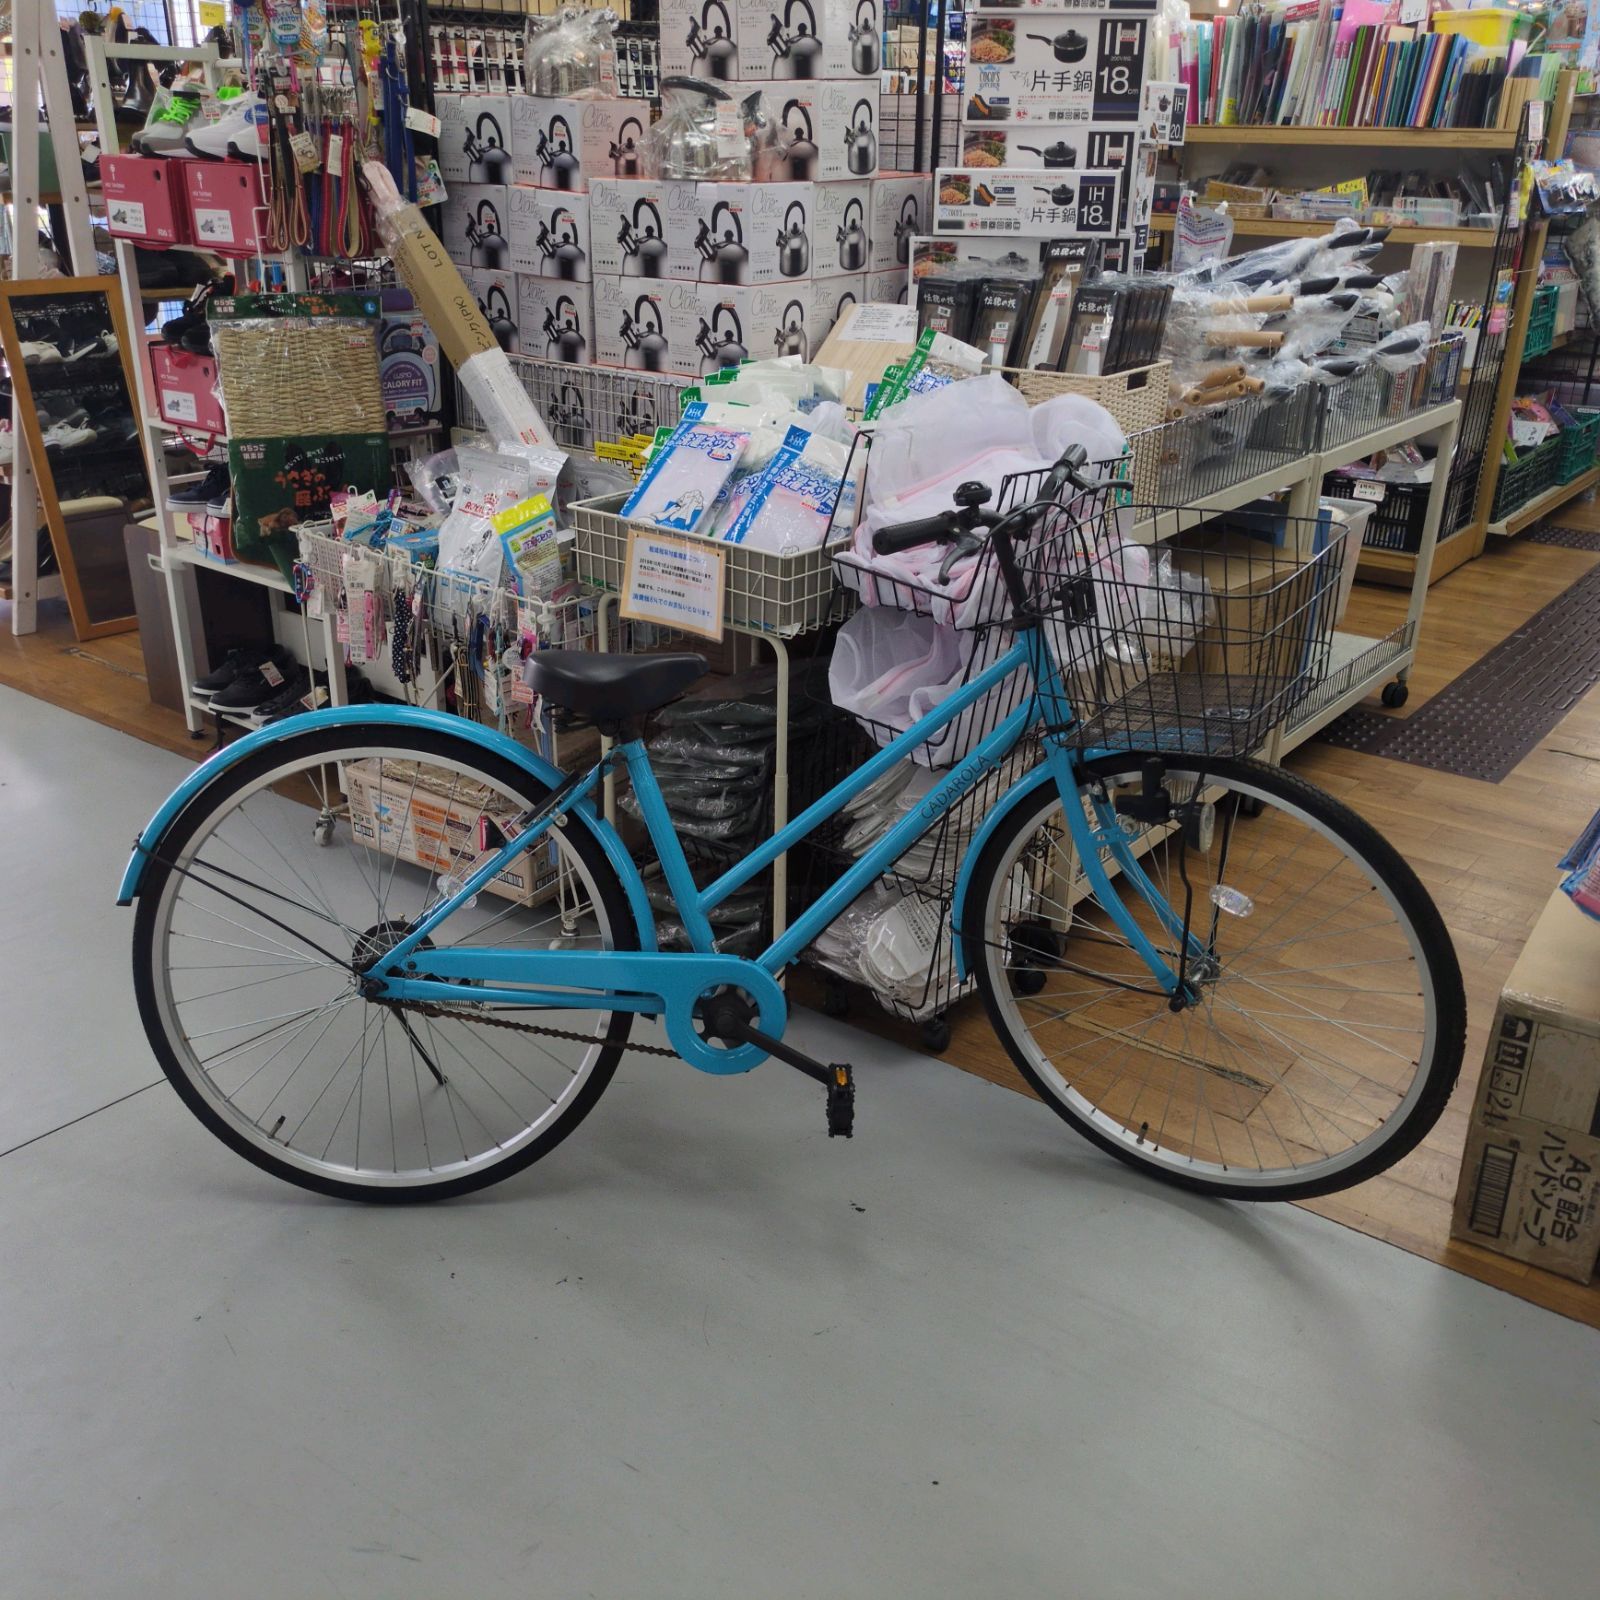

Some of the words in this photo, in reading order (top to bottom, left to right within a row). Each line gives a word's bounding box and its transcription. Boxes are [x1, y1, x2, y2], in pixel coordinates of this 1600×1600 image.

[1031, 69, 1092, 92] 片手鍋
[1088, 187, 1105, 201] IH
[1030, 207, 1077, 224] 片手鍋
[422, 243, 443, 268] LOT
[383, 380, 411, 389] CALORY
[412, 378, 422, 386] FIT
[921, 756, 990, 819] CADAROLA
[1523, 1130, 1567, 1247] ハンドソープ
